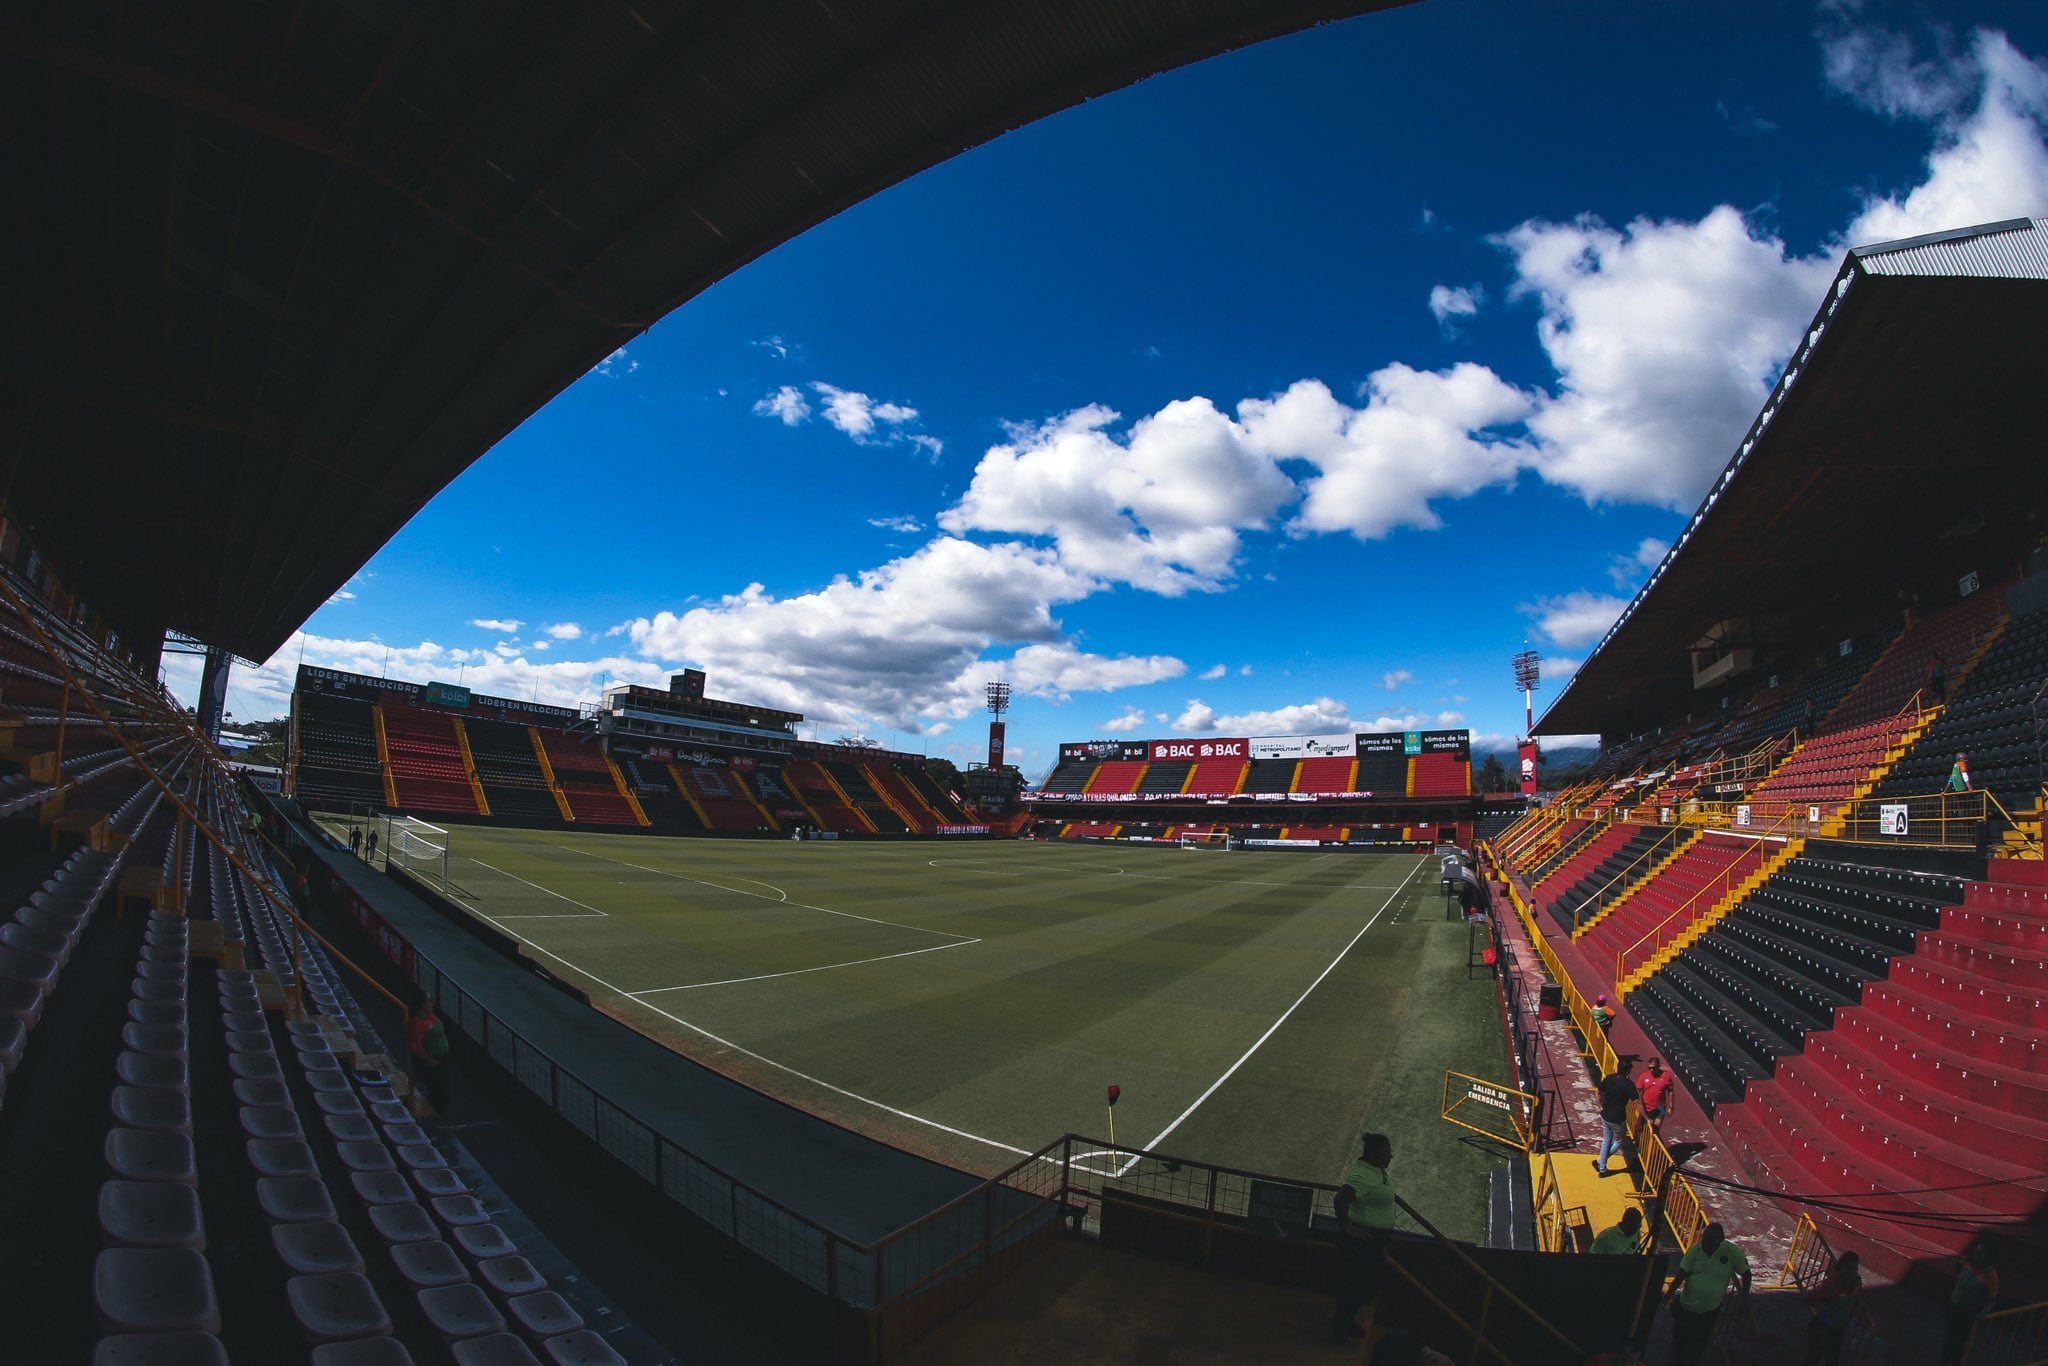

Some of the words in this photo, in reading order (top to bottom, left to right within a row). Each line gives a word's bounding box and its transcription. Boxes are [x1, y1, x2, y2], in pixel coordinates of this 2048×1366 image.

[342, 673, 357, 684] EN
[360, 677, 419, 694] VELOCIDAD
[508, 701, 520, 710] EN
[523, 704, 572, 718] VELOCIDAD
[1170, 745, 1194, 757] BAC
[1215, 743, 1241, 756] BAC
[1313, 744, 1350, 754] medismart
[1472, 1083, 1496, 1097] SALIDA
[1498, 1091, 1508, 1100] DE
[1468, 1091, 1511, 1111] EMERGENCIA
